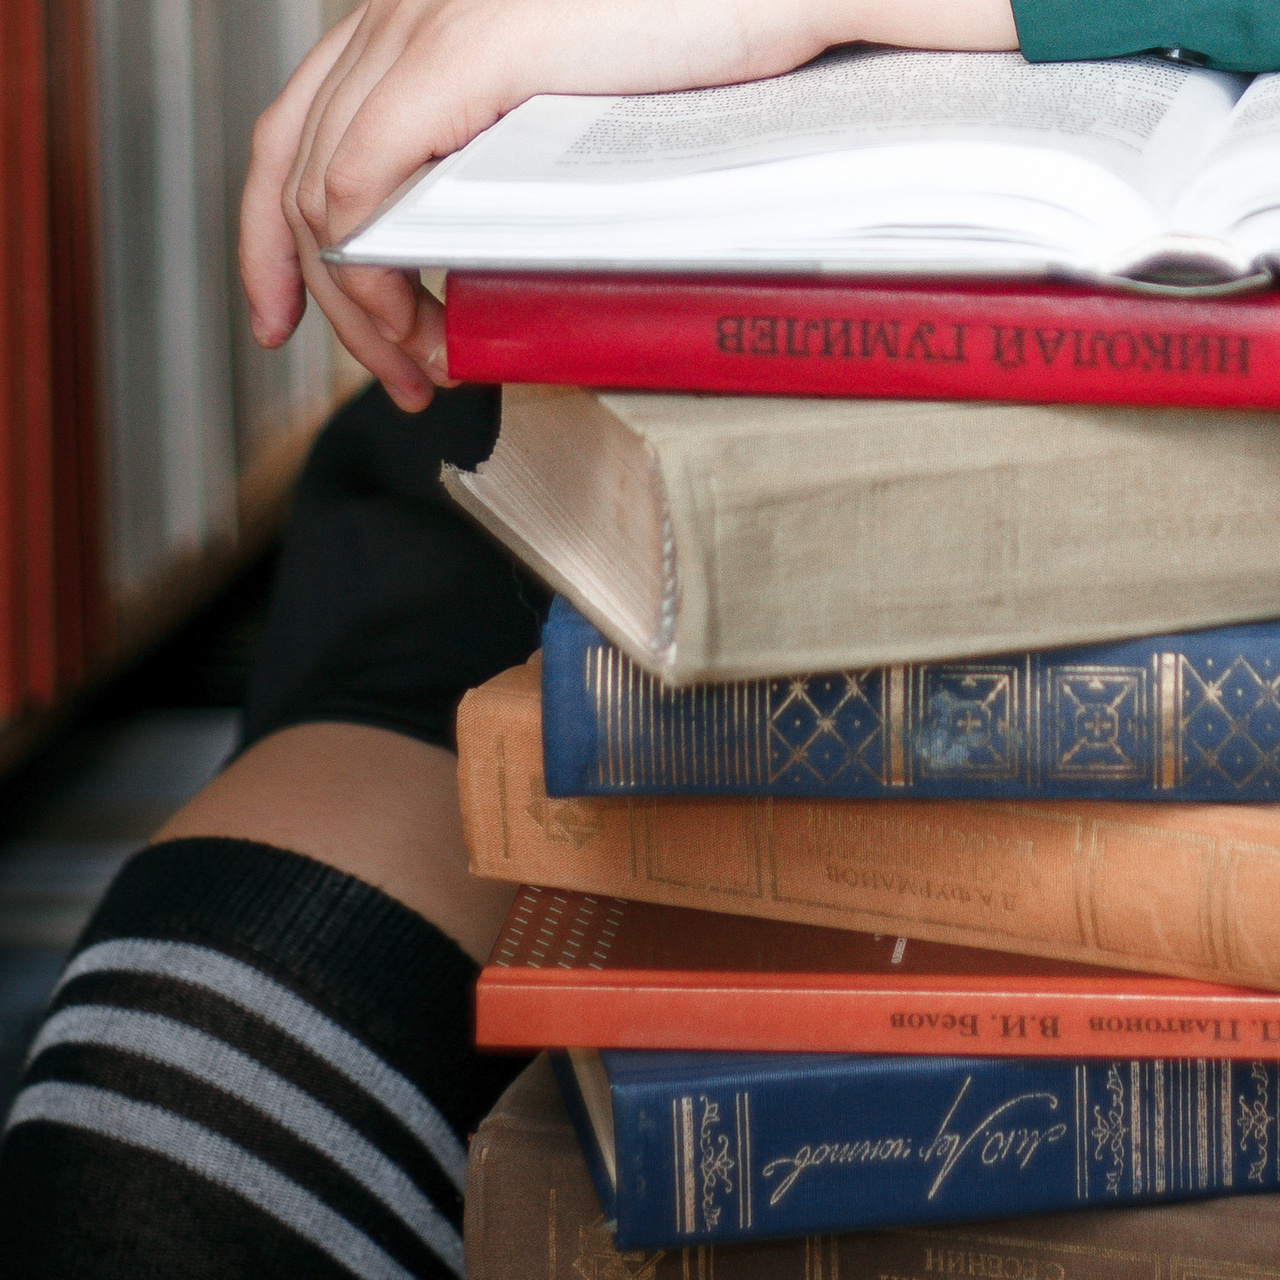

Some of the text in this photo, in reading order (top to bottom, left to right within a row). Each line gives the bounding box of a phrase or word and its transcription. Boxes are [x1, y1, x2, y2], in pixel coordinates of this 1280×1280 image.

[715, 315, 1250, 376] НИКОЛАЙ ГУМИЛЕВ
[889, 1012, 980, 1037] Белов
[1088, 1016, 1242, 1042] Платонов
